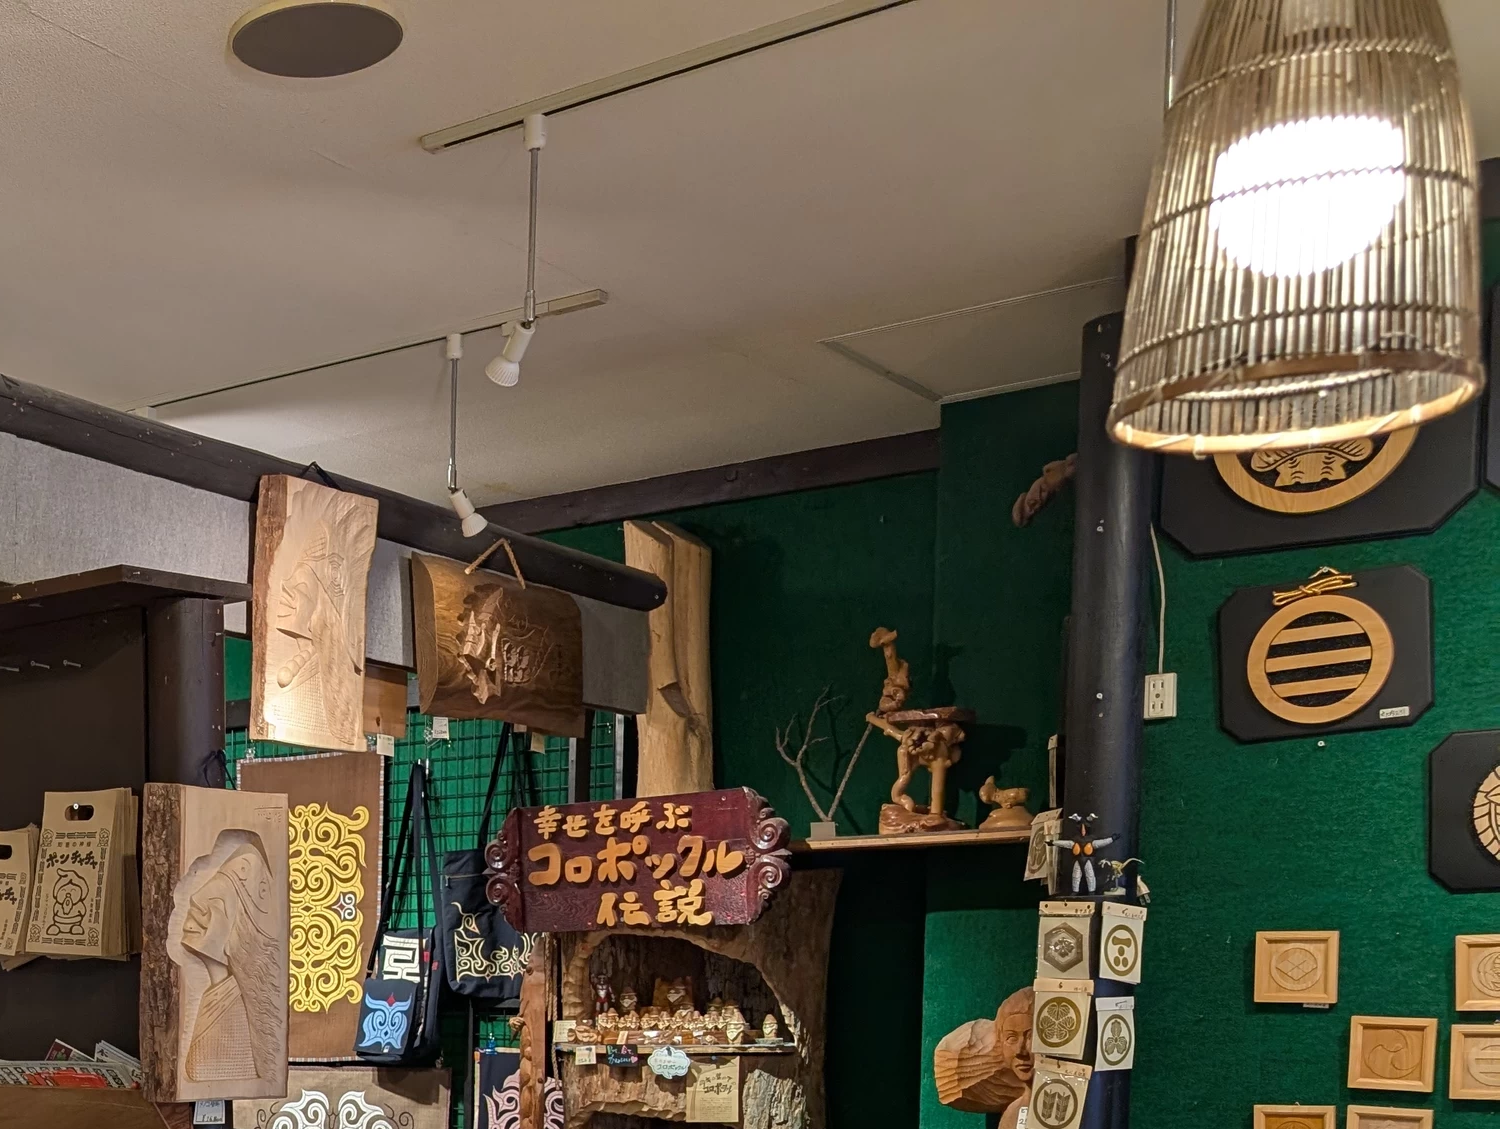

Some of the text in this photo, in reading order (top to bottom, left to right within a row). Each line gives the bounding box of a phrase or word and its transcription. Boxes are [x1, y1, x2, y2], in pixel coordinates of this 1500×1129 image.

[533, 800, 693, 840] 幸せを呼ぶ
[46, 850, 98, 869] ポンチャチャ
[527, 835, 747, 886] コロポックル
[596, 878, 713, 926] 伝説
